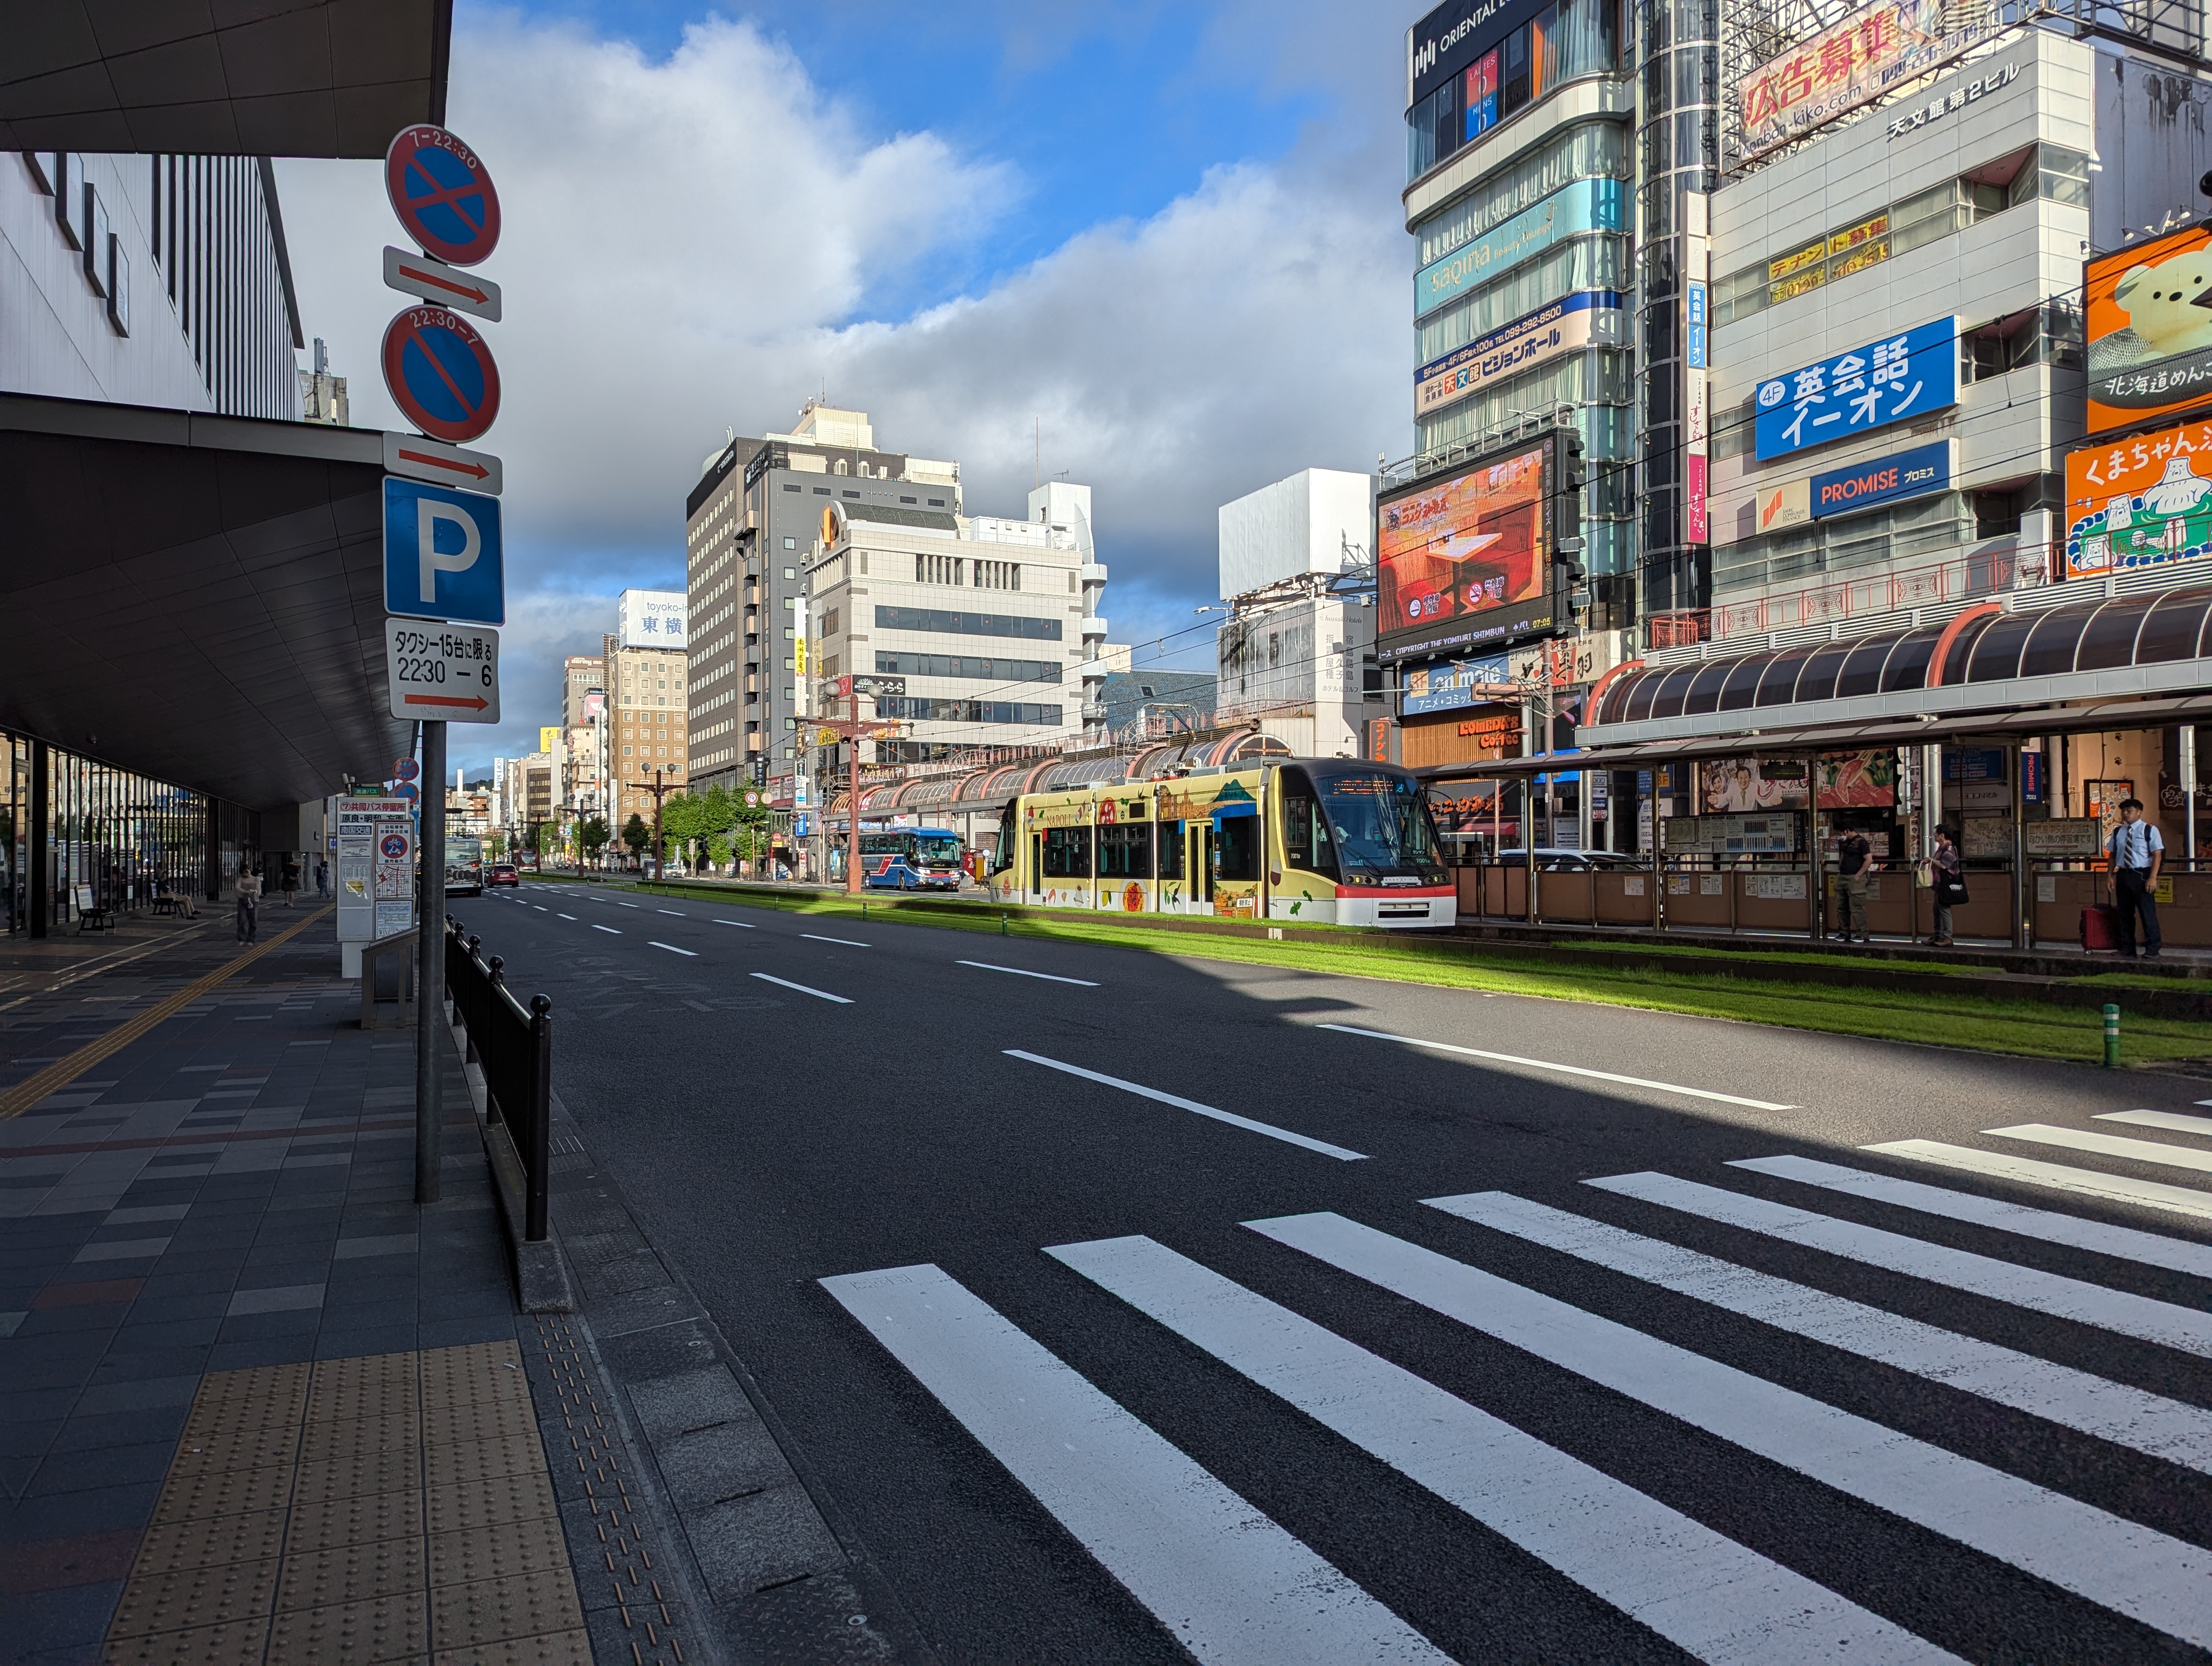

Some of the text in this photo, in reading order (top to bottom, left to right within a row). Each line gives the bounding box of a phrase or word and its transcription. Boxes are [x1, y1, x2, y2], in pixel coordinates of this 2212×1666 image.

[1440, 2, 1497, 52] ORIENTAL
[1744, 8, 1900, 127] 広告募集
[1473, 97, 1492, 116] MNS
[1889, 62, 2020, 140] 天文館第2ビル
[1772, 218, 1887, 278] テナント募集
[1693, 291, 1701, 322] 英会話
[1483, 328, 1560, 376] ビジョンホール
[1693, 327, 1701, 364] イーオン
[1793, 336, 1909, 411] 英会話
[1763, 382, 1784, 405] 4F
[1782, 381, 1924, 446] イーオン
[1821, 467, 1935, 505] PROMISE プロミス
[417, 497, 481, 603] P
[640, 616, 683, 635] 東横
[1473, 625, 1505, 640] SHIMBUN
[1533, 617, 1551, 629] 07:05
[396, 631, 492, 661] タクシー15台に限る
[398, 657, 446, 683] 22:30
[481, 664, 492, 687] 6
[1326, 670, 1354, 680] 種子島
[1435, 664, 1501, 694] animate
[1459, 716, 1519, 736] KOMEDA'S
[340, 826, 371, 835] 南国交通
[1046, 813, 1071, 827] NAPOLI
